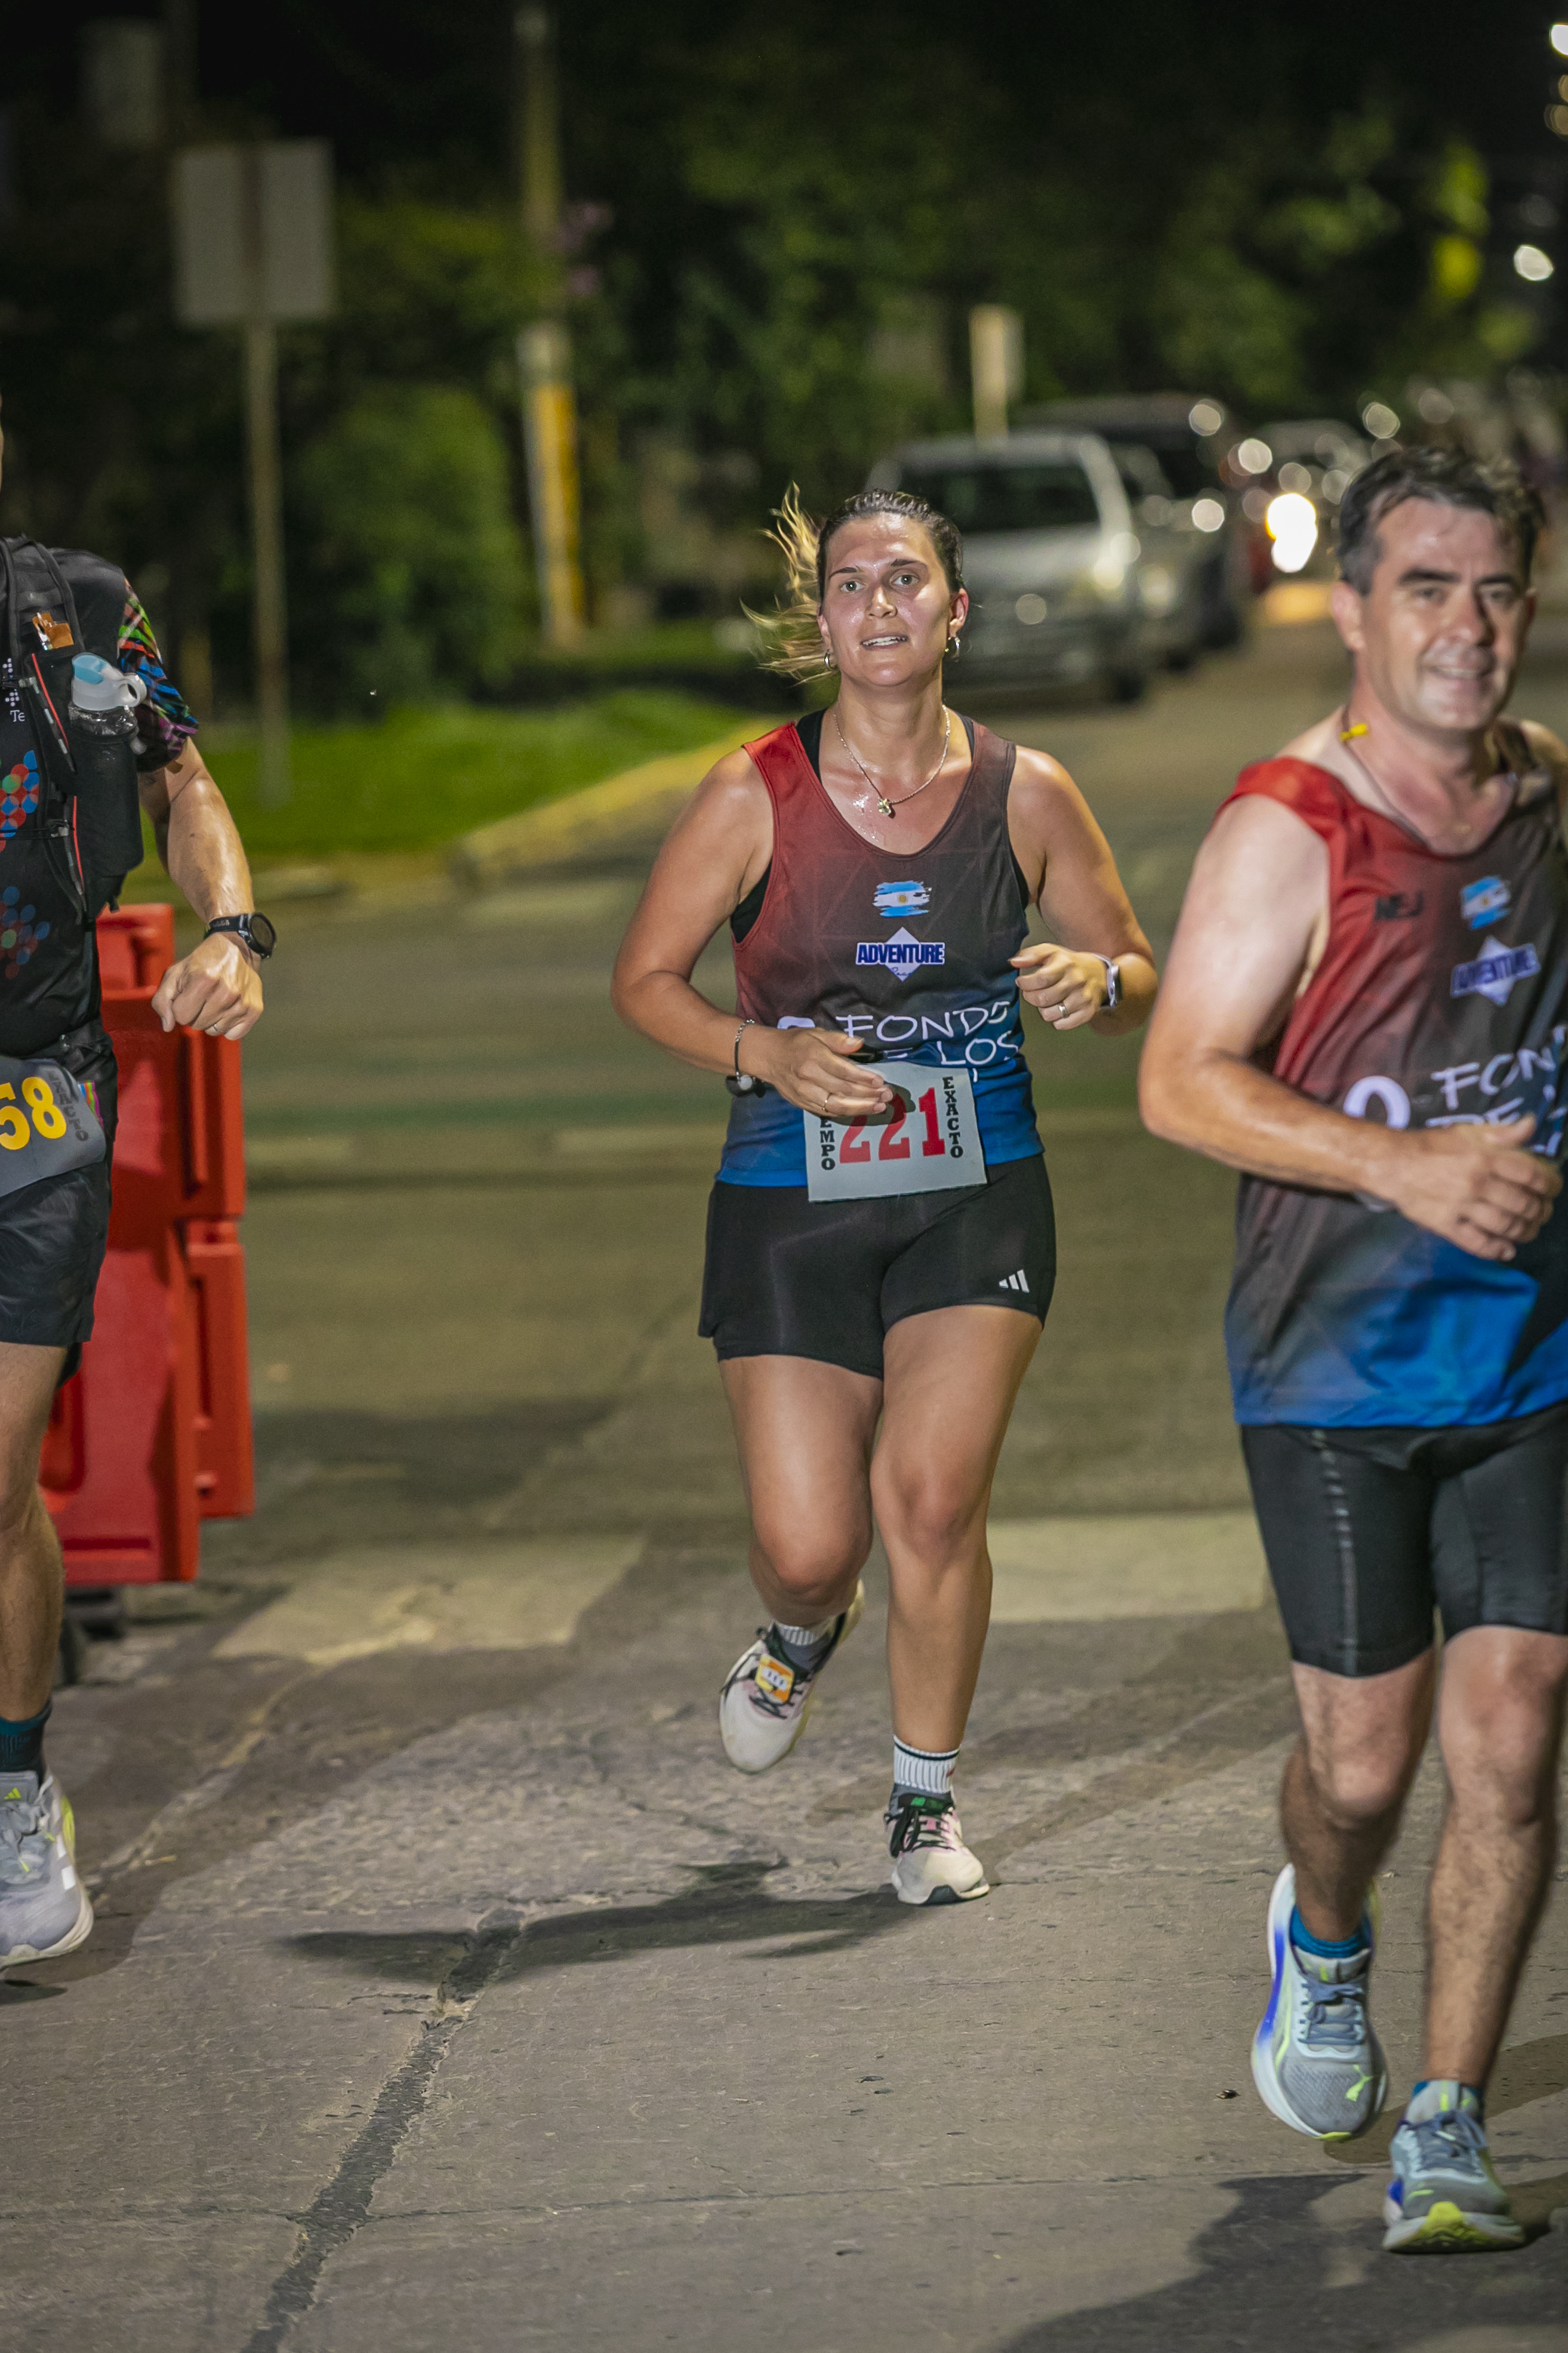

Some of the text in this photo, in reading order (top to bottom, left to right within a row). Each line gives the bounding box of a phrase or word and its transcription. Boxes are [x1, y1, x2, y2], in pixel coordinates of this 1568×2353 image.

[857, 943, 944, 964] ADVENTURE
[839, 1087, 946, 1164] 221
[942, 1076, 964, 1159] EXACTO
